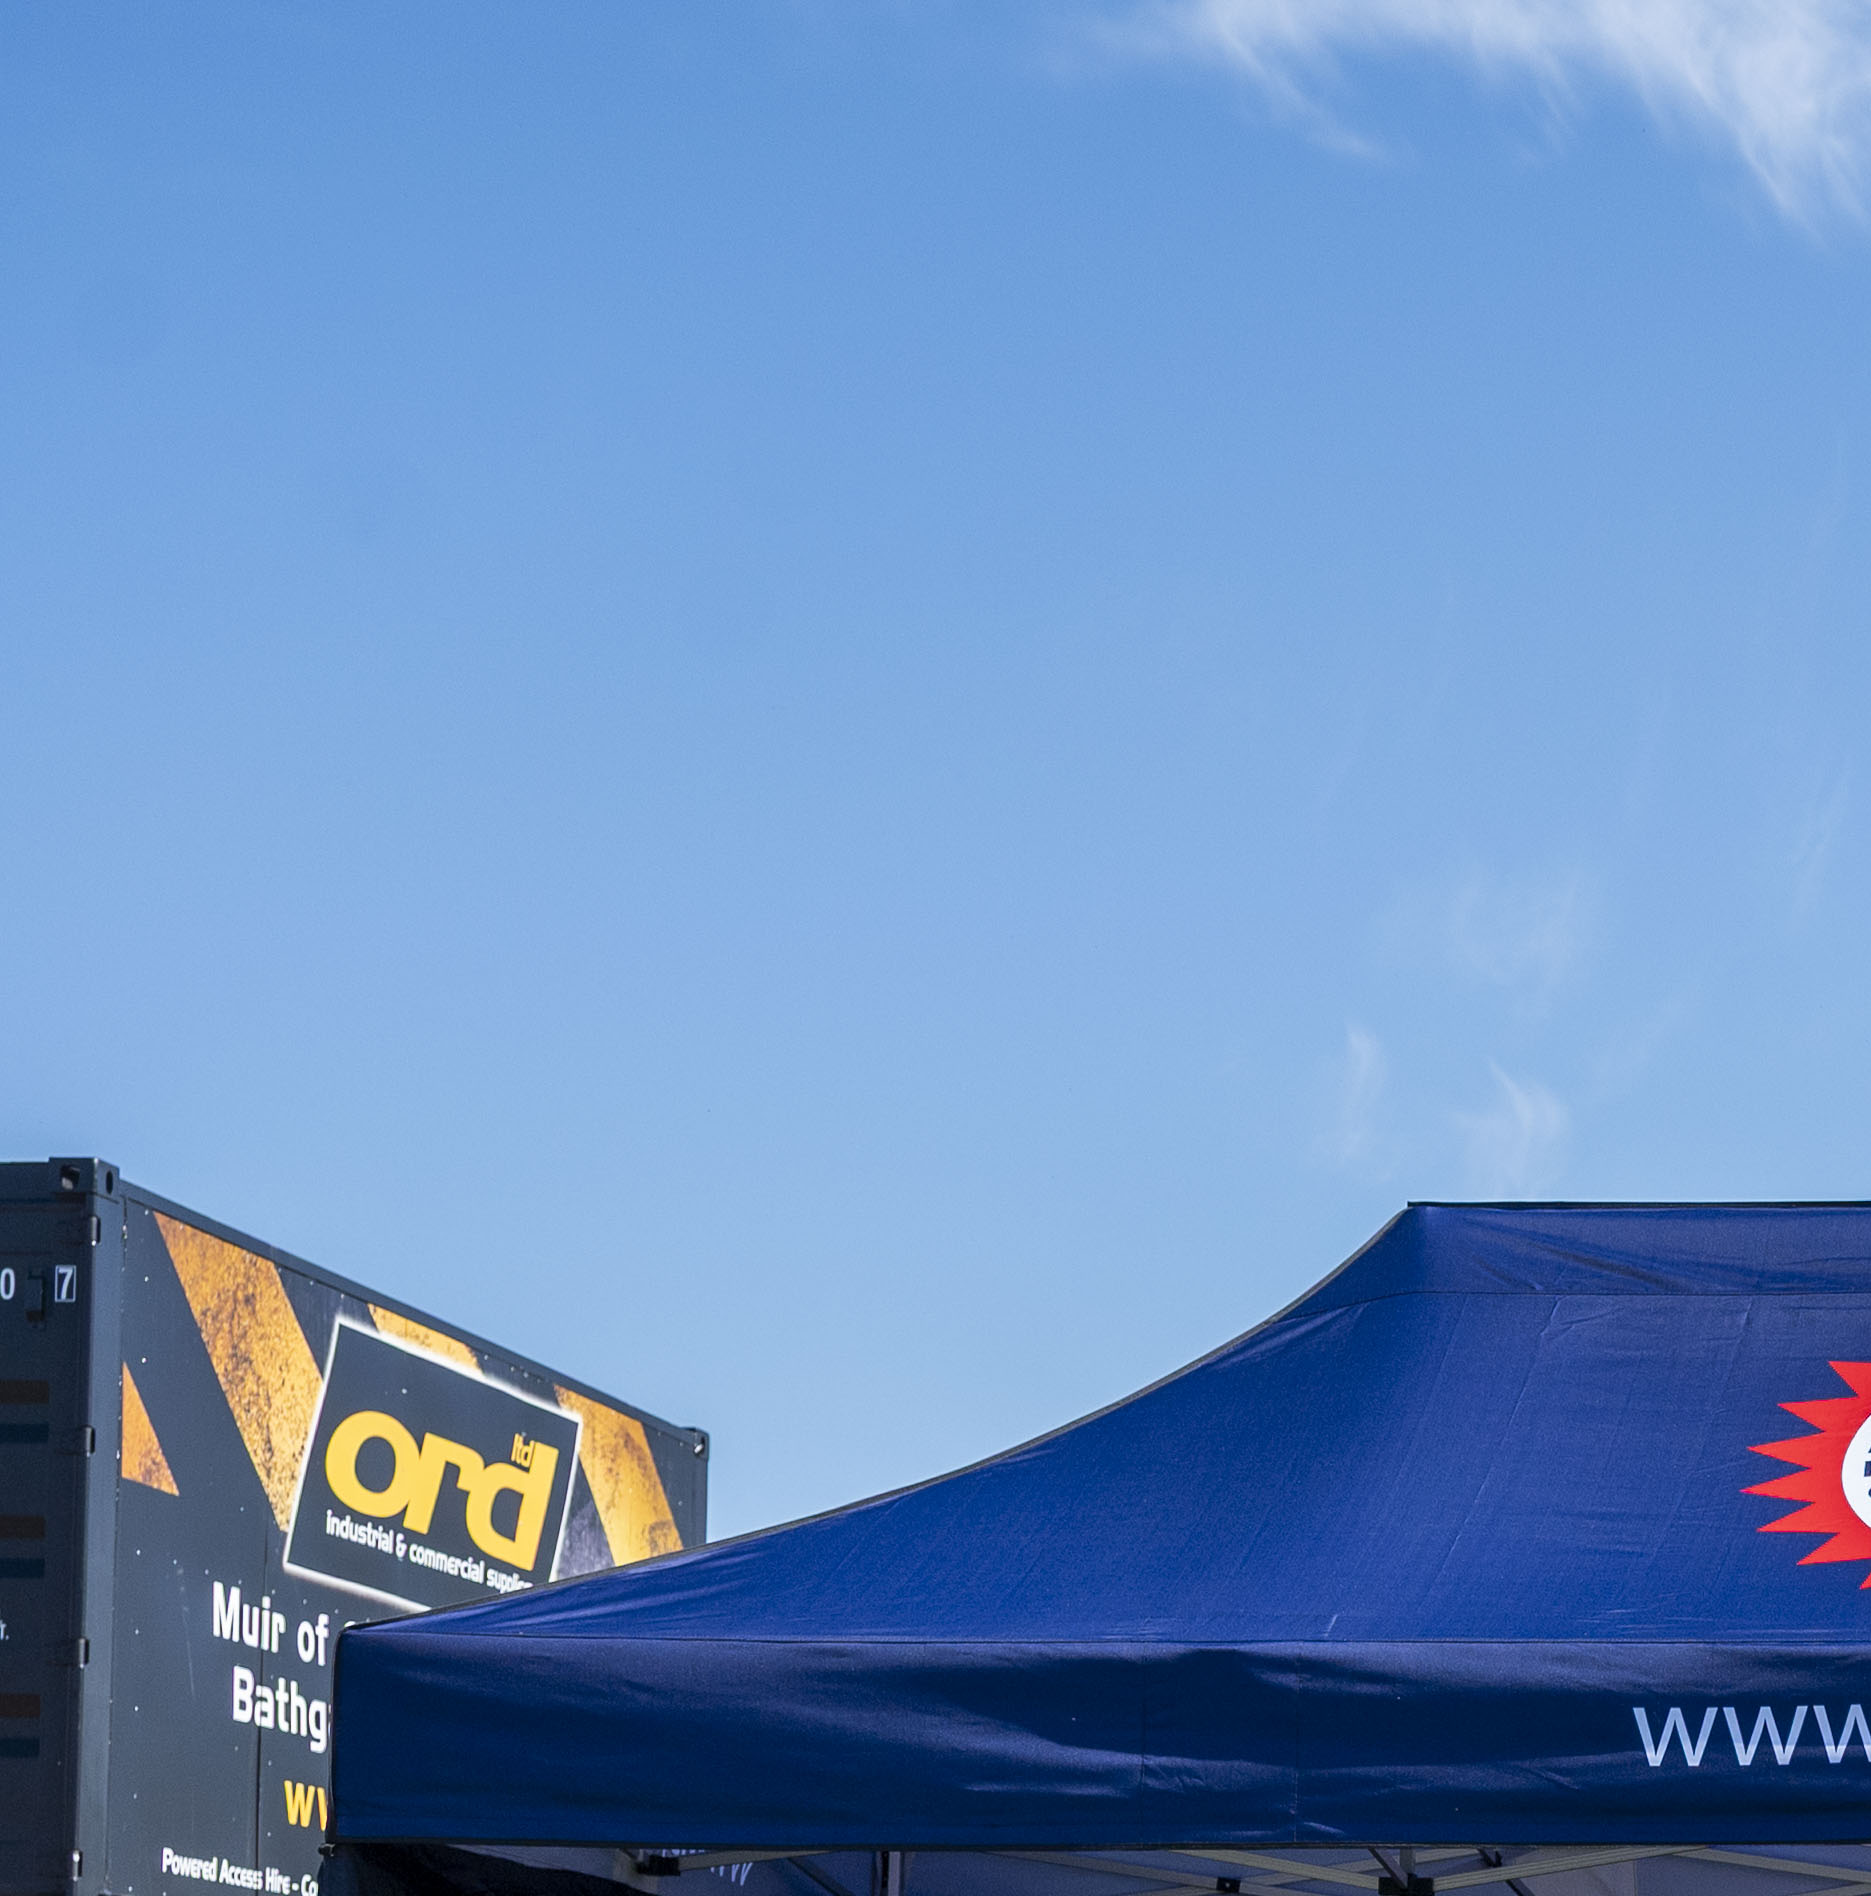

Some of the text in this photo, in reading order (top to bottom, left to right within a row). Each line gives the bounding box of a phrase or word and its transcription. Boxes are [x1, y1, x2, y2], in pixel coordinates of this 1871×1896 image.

[511, 1432, 534, 1469] ltd
[325, 1411, 559, 1571] ord
[326, 1509, 394, 1554] industrial
[396, 1533, 407, 1557] &
[409, 1543, 485, 1584] commercial
[213, 1581, 329, 1666] Muir of
[233, 1666, 331, 1753] Bathg
[162, 1847, 217, 1881] Powered
[219, 1859, 262, 1890] Access
[264, 1867, 290, 1895] Hire
